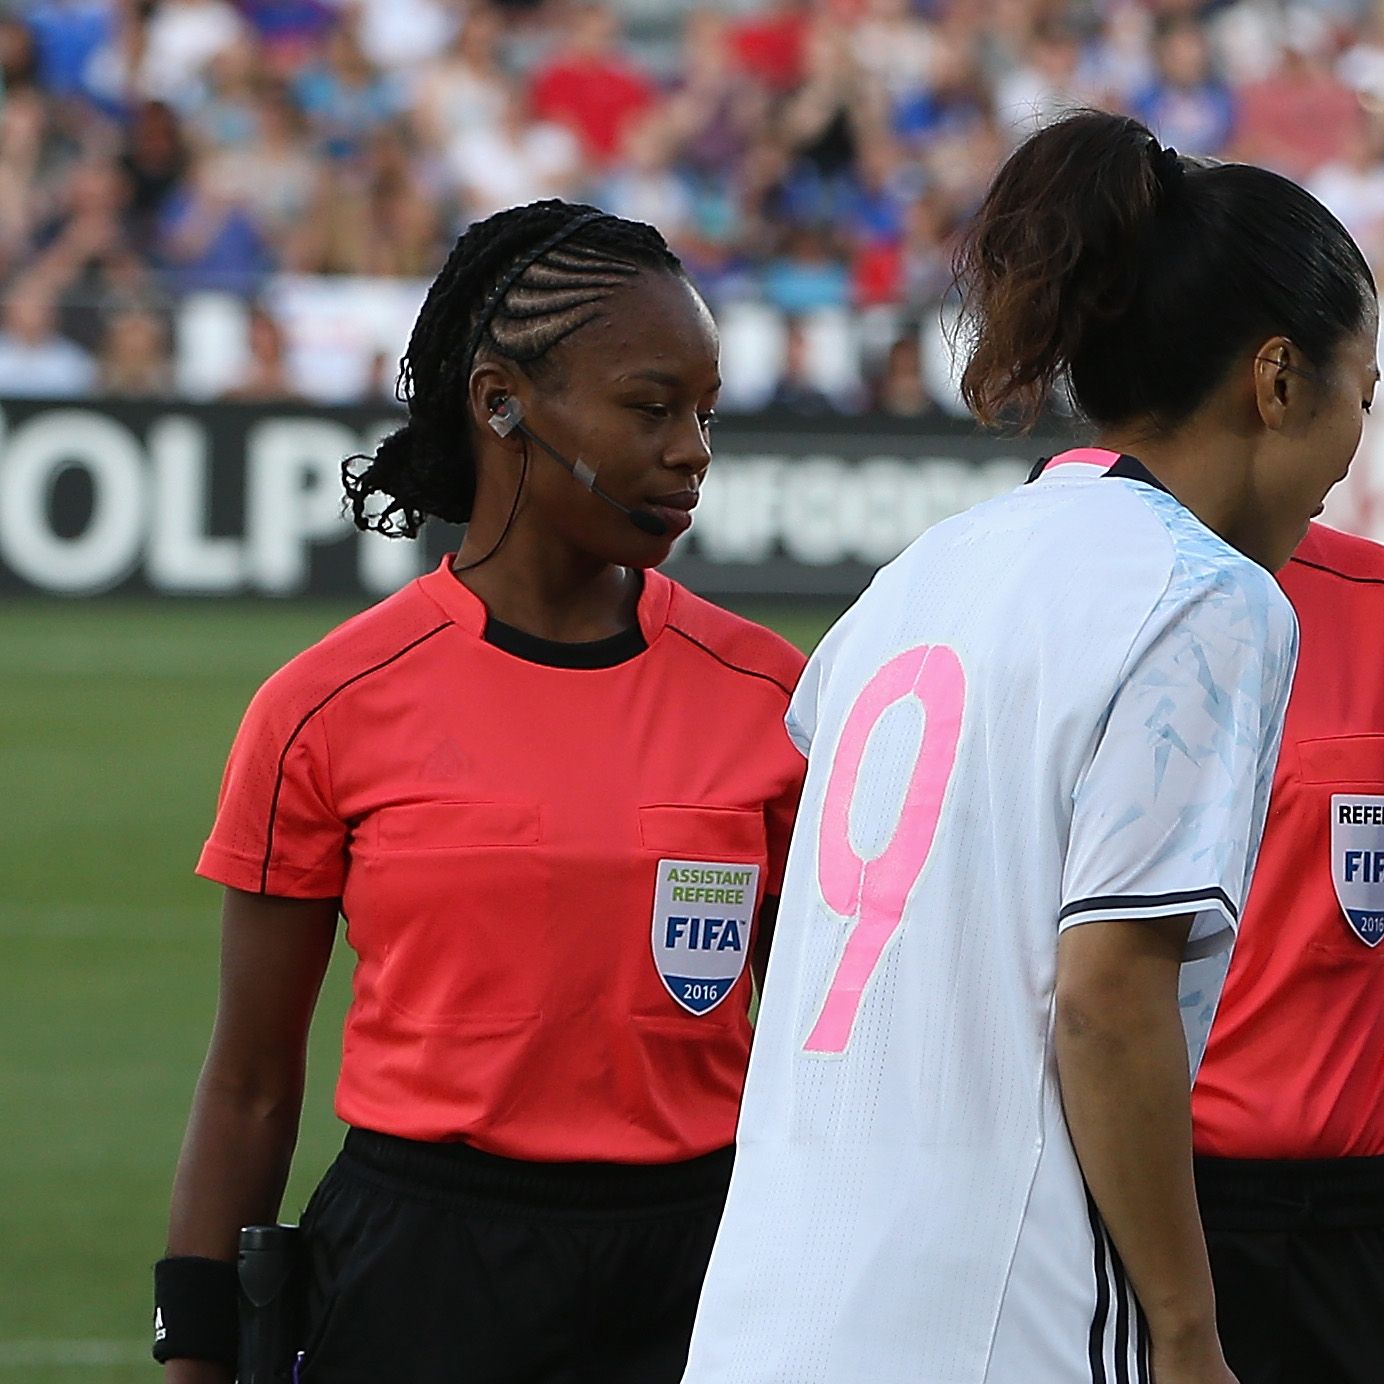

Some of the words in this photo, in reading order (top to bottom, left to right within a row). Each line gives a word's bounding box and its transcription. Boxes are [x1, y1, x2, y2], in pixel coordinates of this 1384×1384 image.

[802, 643, 967, 1053] 9
[667, 868, 752, 886] ASSISTANT
[672, 886, 744, 904] REFEREE
[1360, 916, 1384, 933] 2016
[665, 916, 742, 952] FIFA
[683, 983, 718, 1001] 2016
